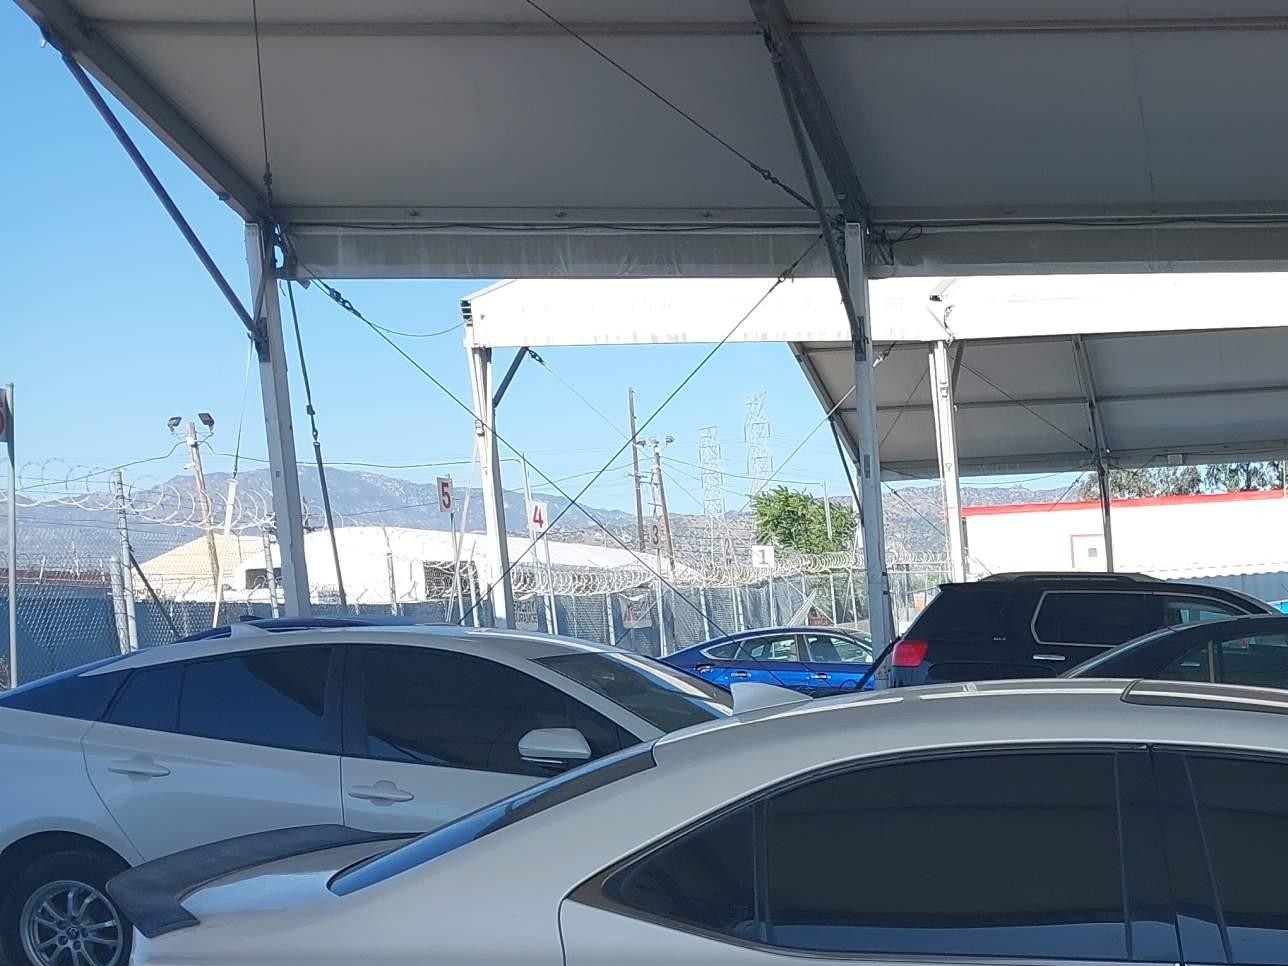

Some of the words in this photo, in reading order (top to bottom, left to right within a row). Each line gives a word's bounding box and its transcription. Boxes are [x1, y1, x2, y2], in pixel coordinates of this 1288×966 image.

[440, 481, 452, 509] 5
[532, 504, 544, 529] 4
[651, 524, 659, 545] 3
[758, 549, 769, 565] 1
